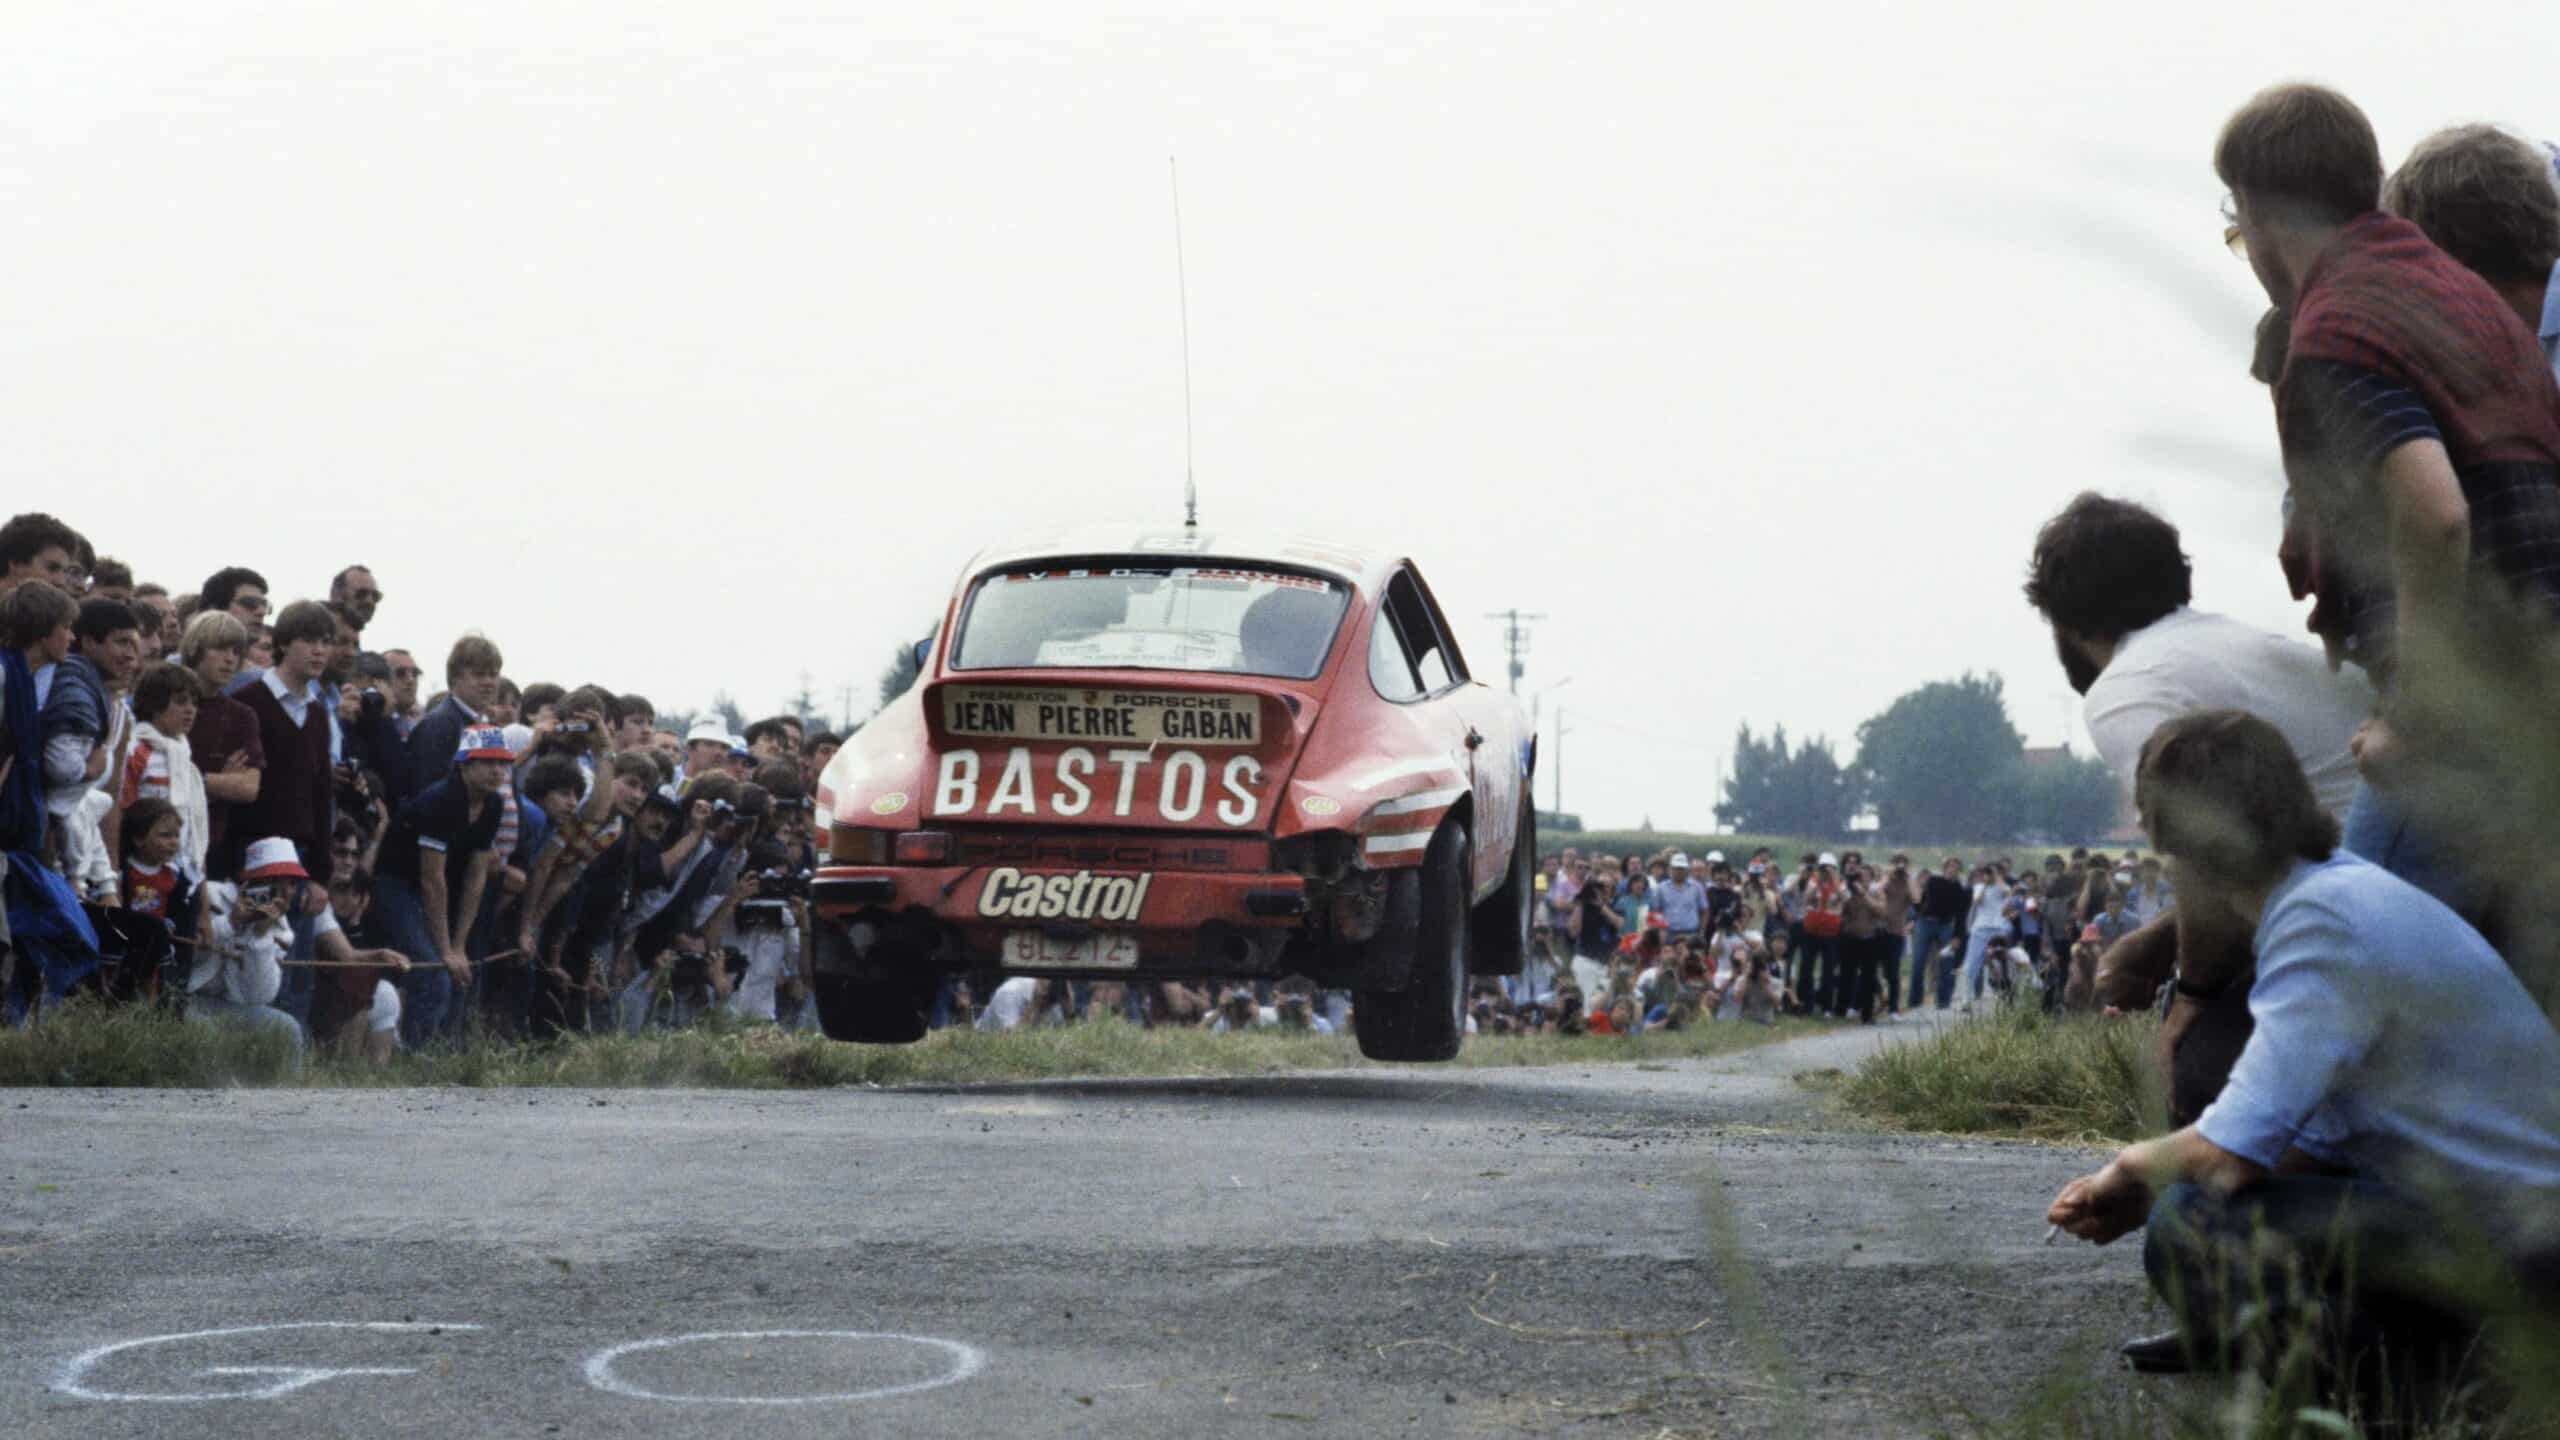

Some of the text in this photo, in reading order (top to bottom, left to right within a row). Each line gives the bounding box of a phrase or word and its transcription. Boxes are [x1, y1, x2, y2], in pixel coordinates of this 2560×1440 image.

[953, 702, 1253, 739] JEAN PIERRE GABAN
[1113, 694, 1232, 709] PORSCHE
[934, 747, 1262, 826] BASTOS
[979, 867, 1151, 920] Castrol
